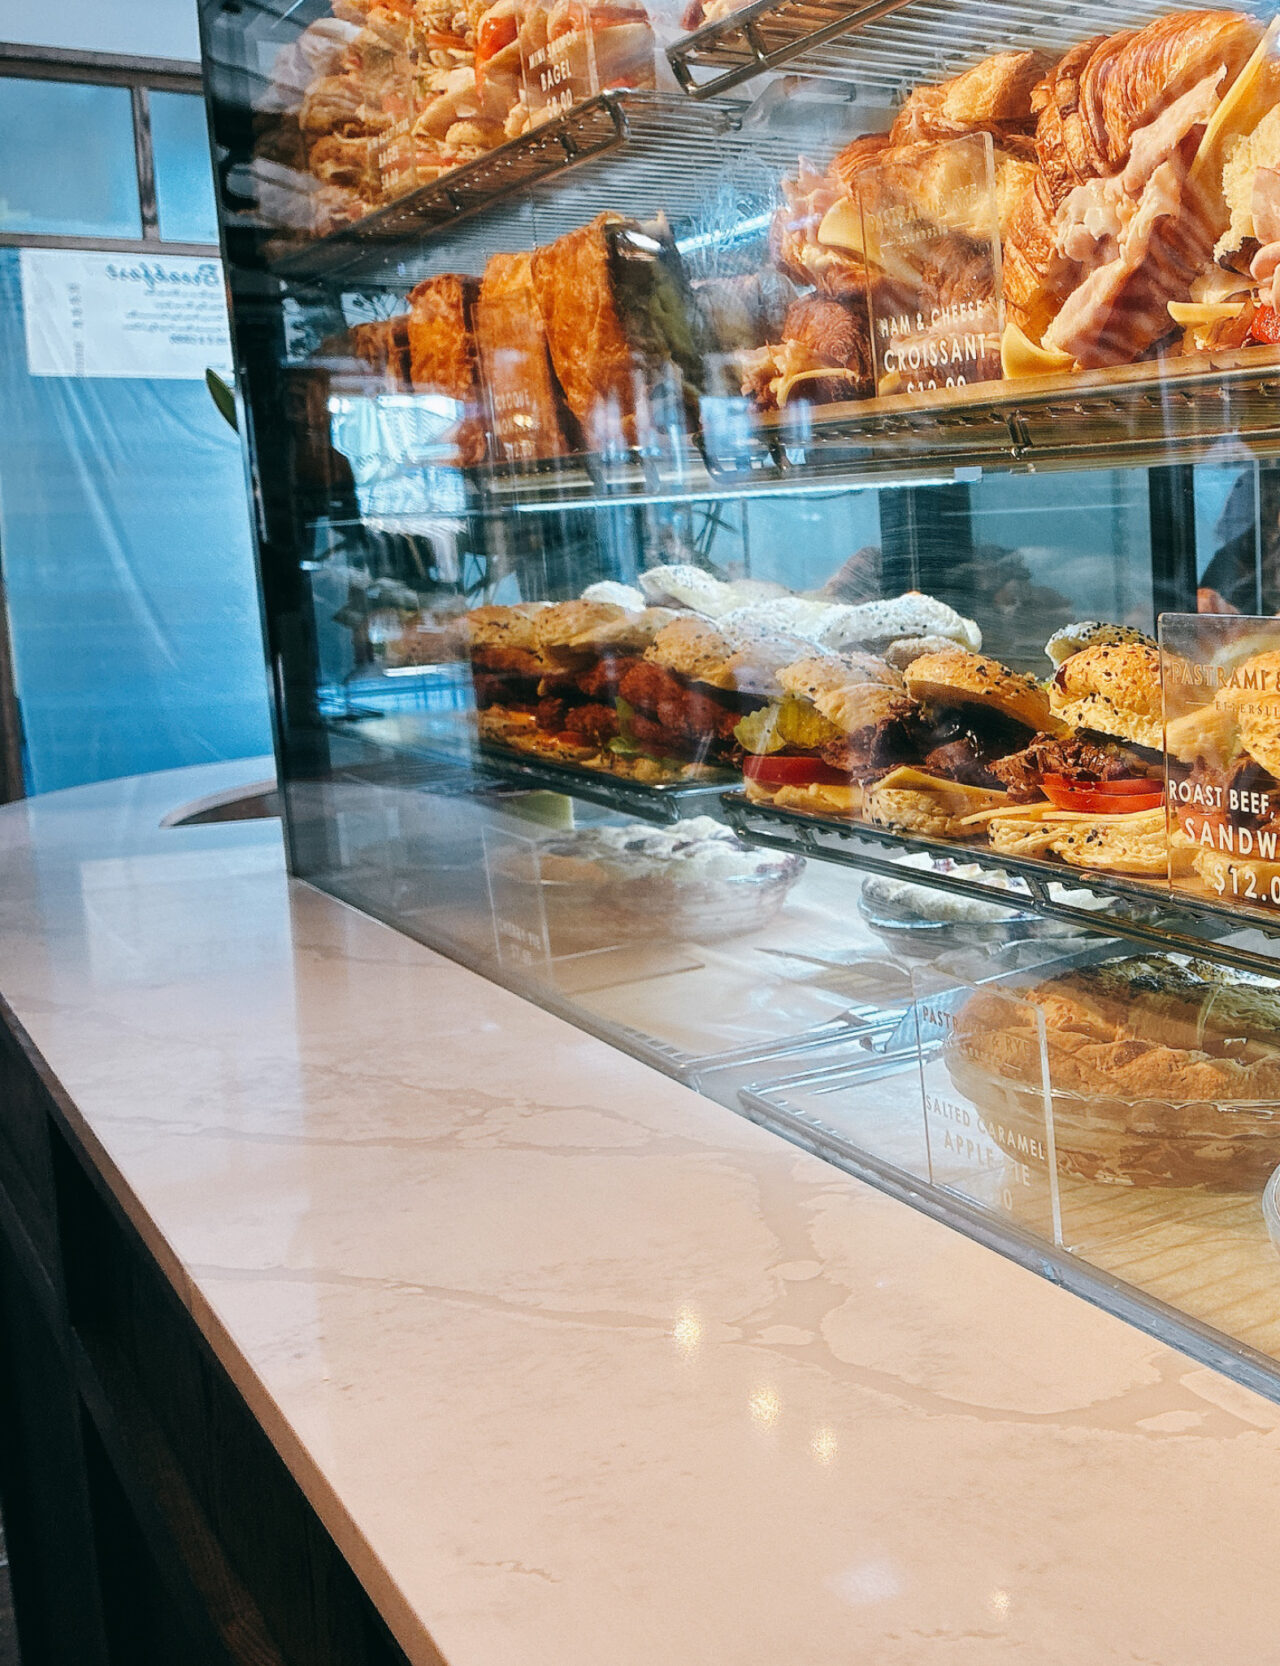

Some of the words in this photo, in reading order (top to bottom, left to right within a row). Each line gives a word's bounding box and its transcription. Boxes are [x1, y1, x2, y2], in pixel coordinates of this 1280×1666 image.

[540, 58, 572, 92] BAGEL
[878, 314, 911, 338] HAM
[916, 312, 925, 331] &
[931, 299, 984, 327] CHEESE
[884, 333, 986, 373] CROISSANT
[1171, 662, 1267, 691] PASTRAMI
[1168, 779, 1223, 808] ROAST
[1229, 788, 1275, 819] BEEF,
[925, 1094, 970, 1128] SALTED
[977, 1117, 1045, 1160] CARAMEL
[944, 1128, 994, 1171] APPLE
